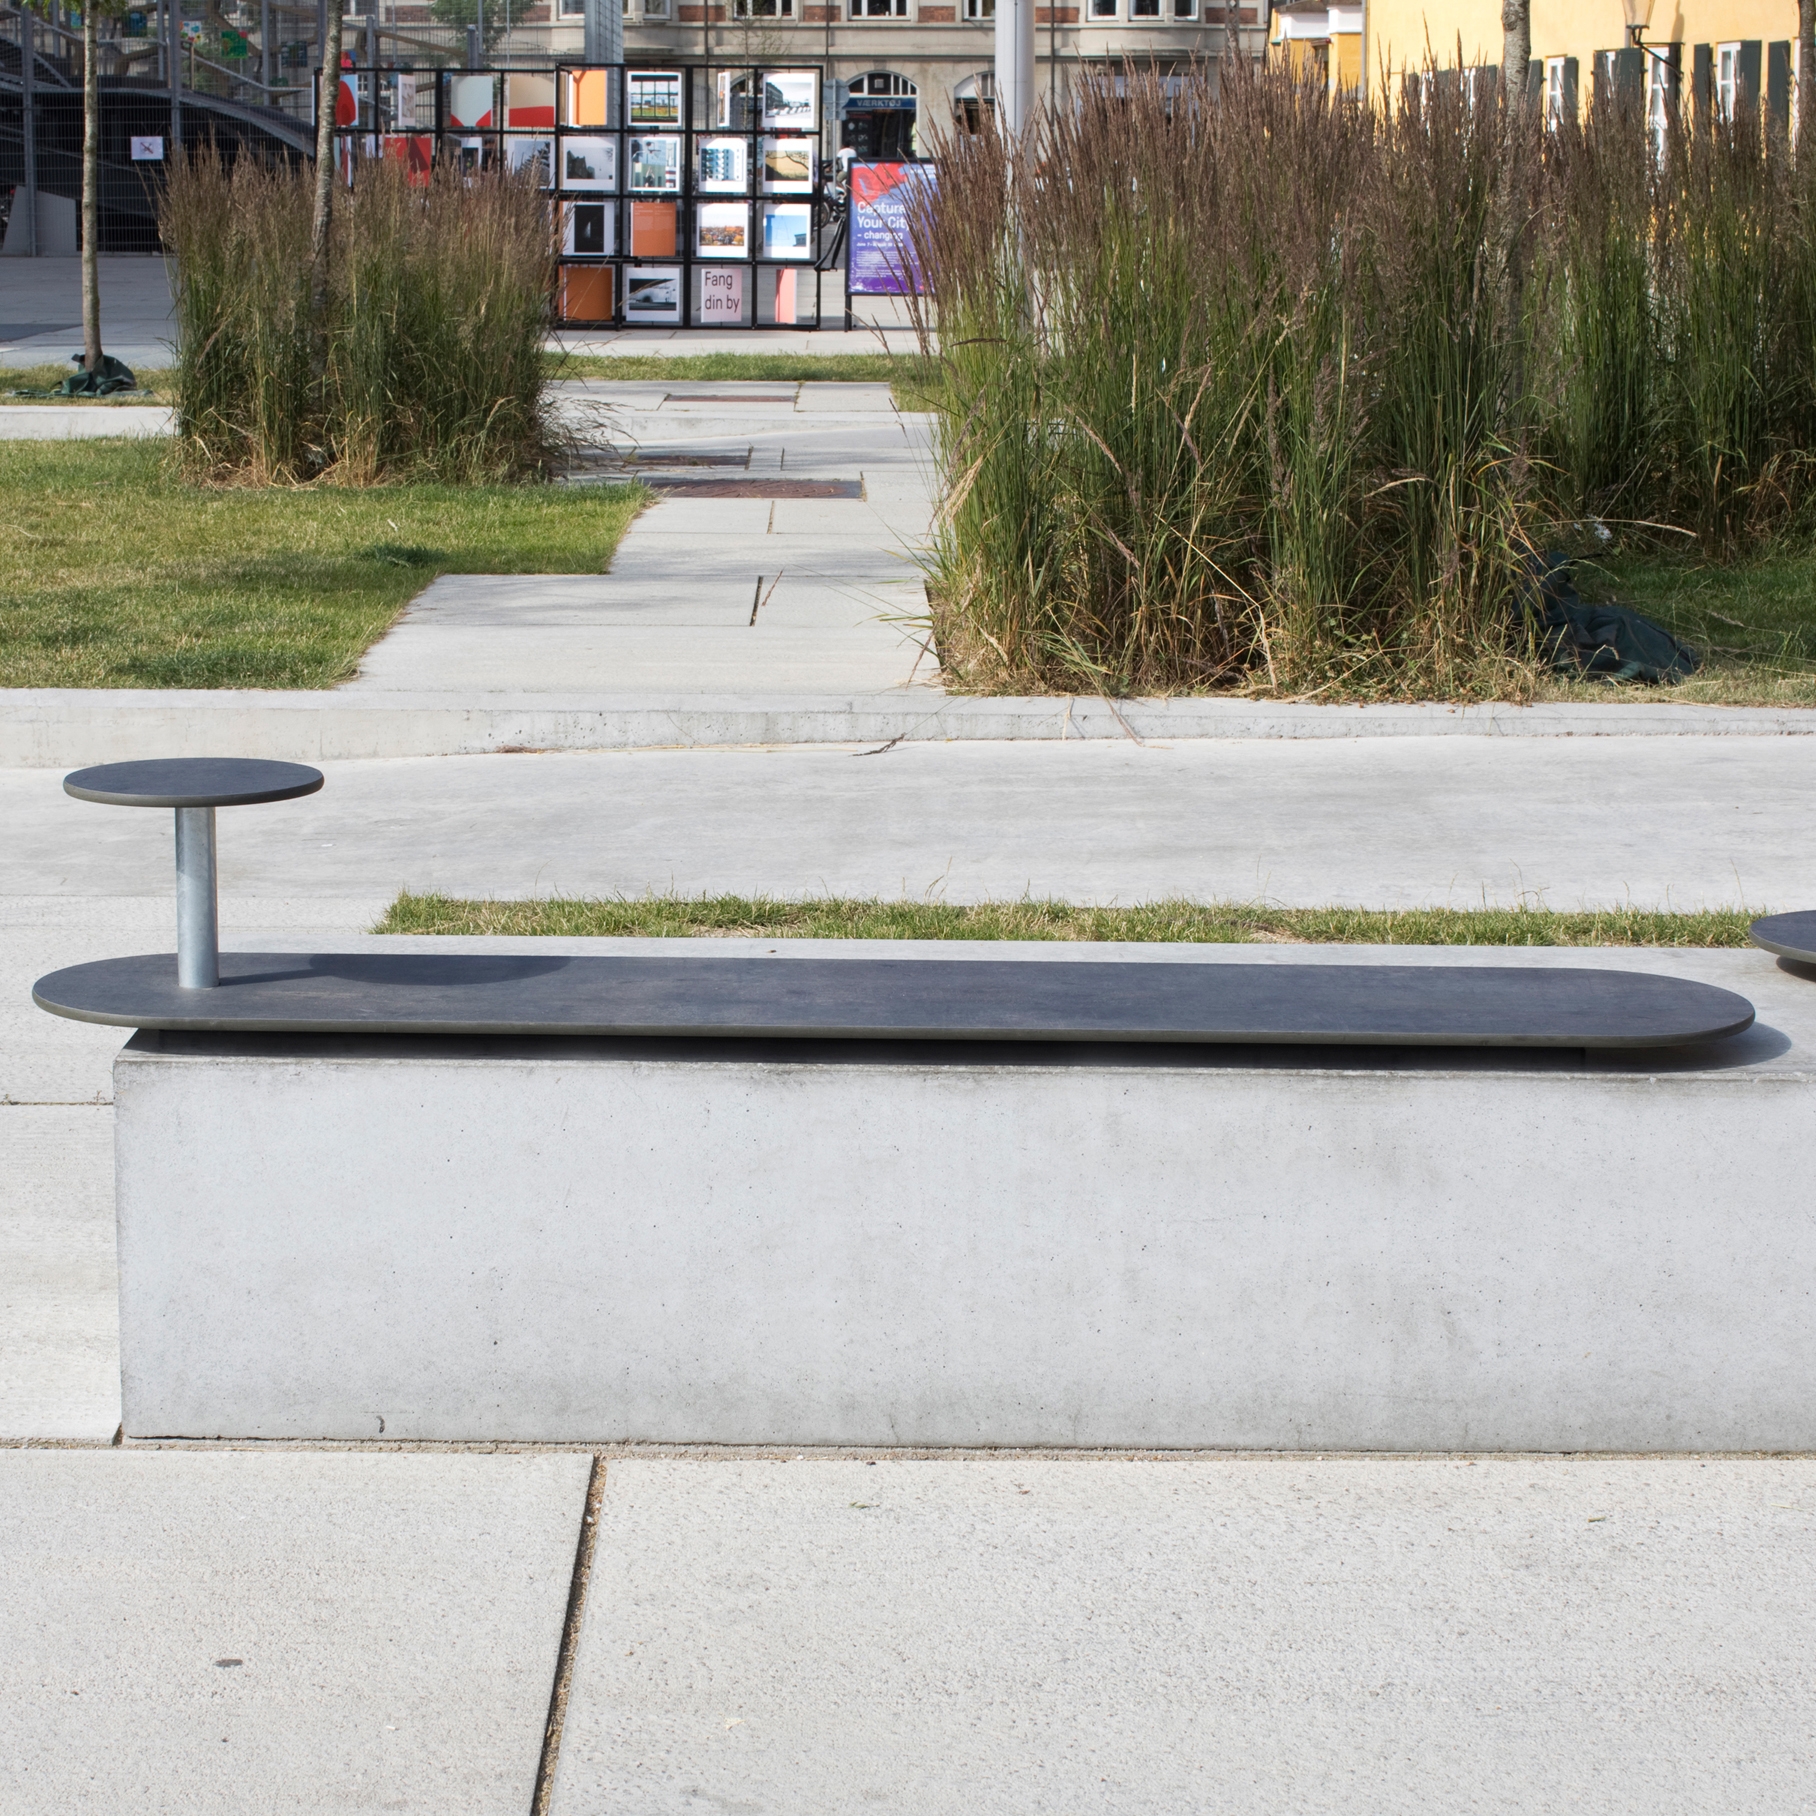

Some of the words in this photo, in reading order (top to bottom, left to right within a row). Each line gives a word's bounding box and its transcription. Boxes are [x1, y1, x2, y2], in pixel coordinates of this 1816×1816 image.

[857, 99, 901, 107] VÆRKTØJ
[857, 201, 906, 216] Capture
[857, 216, 883, 228] Your
[705, 271, 733, 290] Fang
[704, 294, 723, 310] din
[726, 294, 740, 313] by
